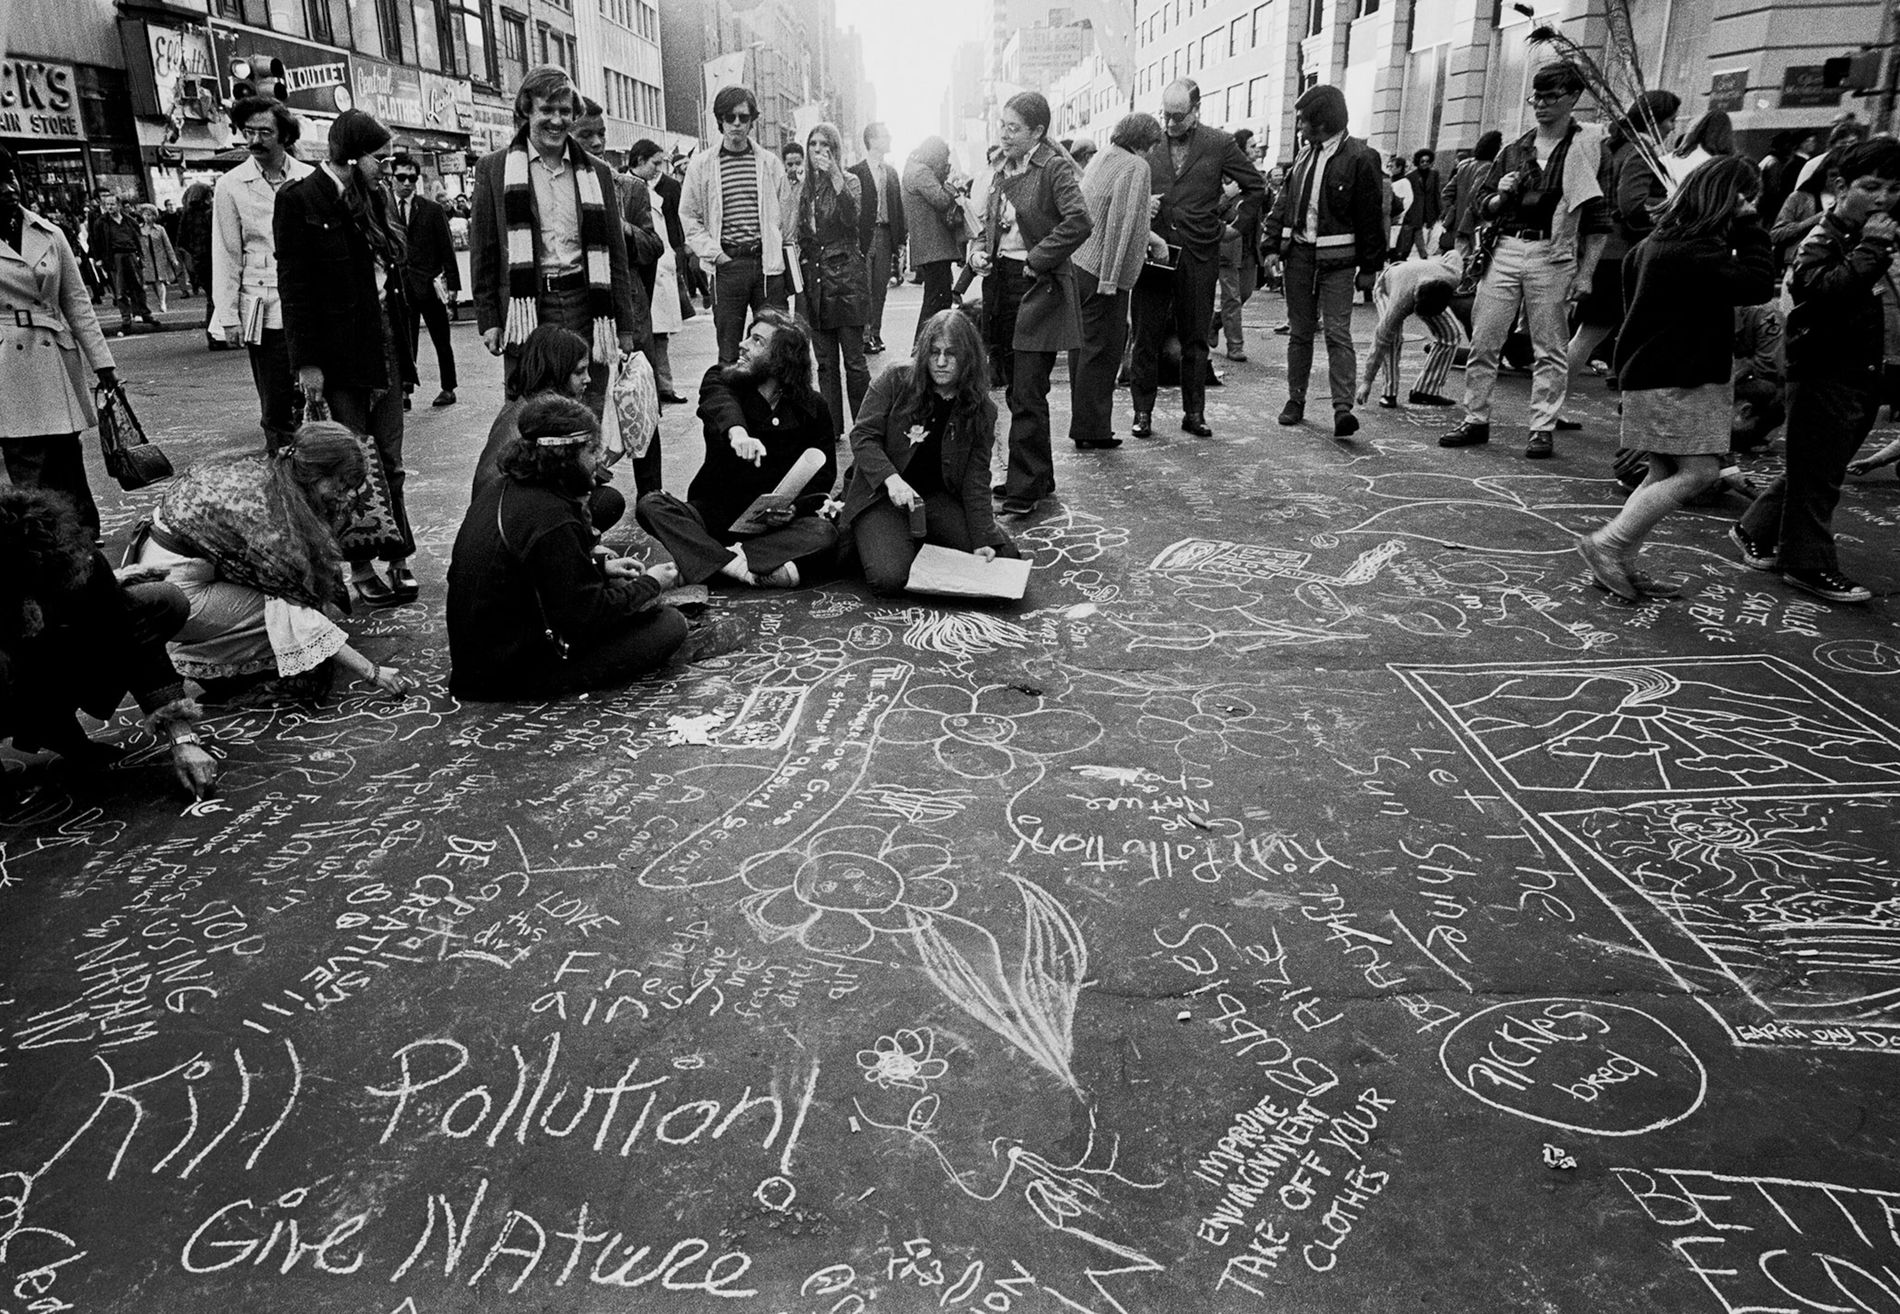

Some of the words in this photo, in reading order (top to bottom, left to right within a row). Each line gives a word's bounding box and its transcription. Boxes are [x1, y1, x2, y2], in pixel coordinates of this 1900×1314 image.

[299, 63, 345, 88] OUTLET
[357, 65, 394, 97] Central
[30, 114, 78, 136] STORE
[377, 94, 424, 126] CLOTHES
[1688, 602, 1737, 643] PEACE
[1735, 591, 1779, 628] SKATE
[1777, 600, 1832, 638] ROLLER
[1811, 1027, 1857, 1046] DAY
[1193, 1095, 1290, 1186] IMPROVE
[1215, 1218, 1291, 1296] TAKE
[1279, 1149, 1332, 1210] OFF
[1319, 1087, 1397, 1160] YOUR
[1303, 1165, 1390, 1272] CLOTHES
